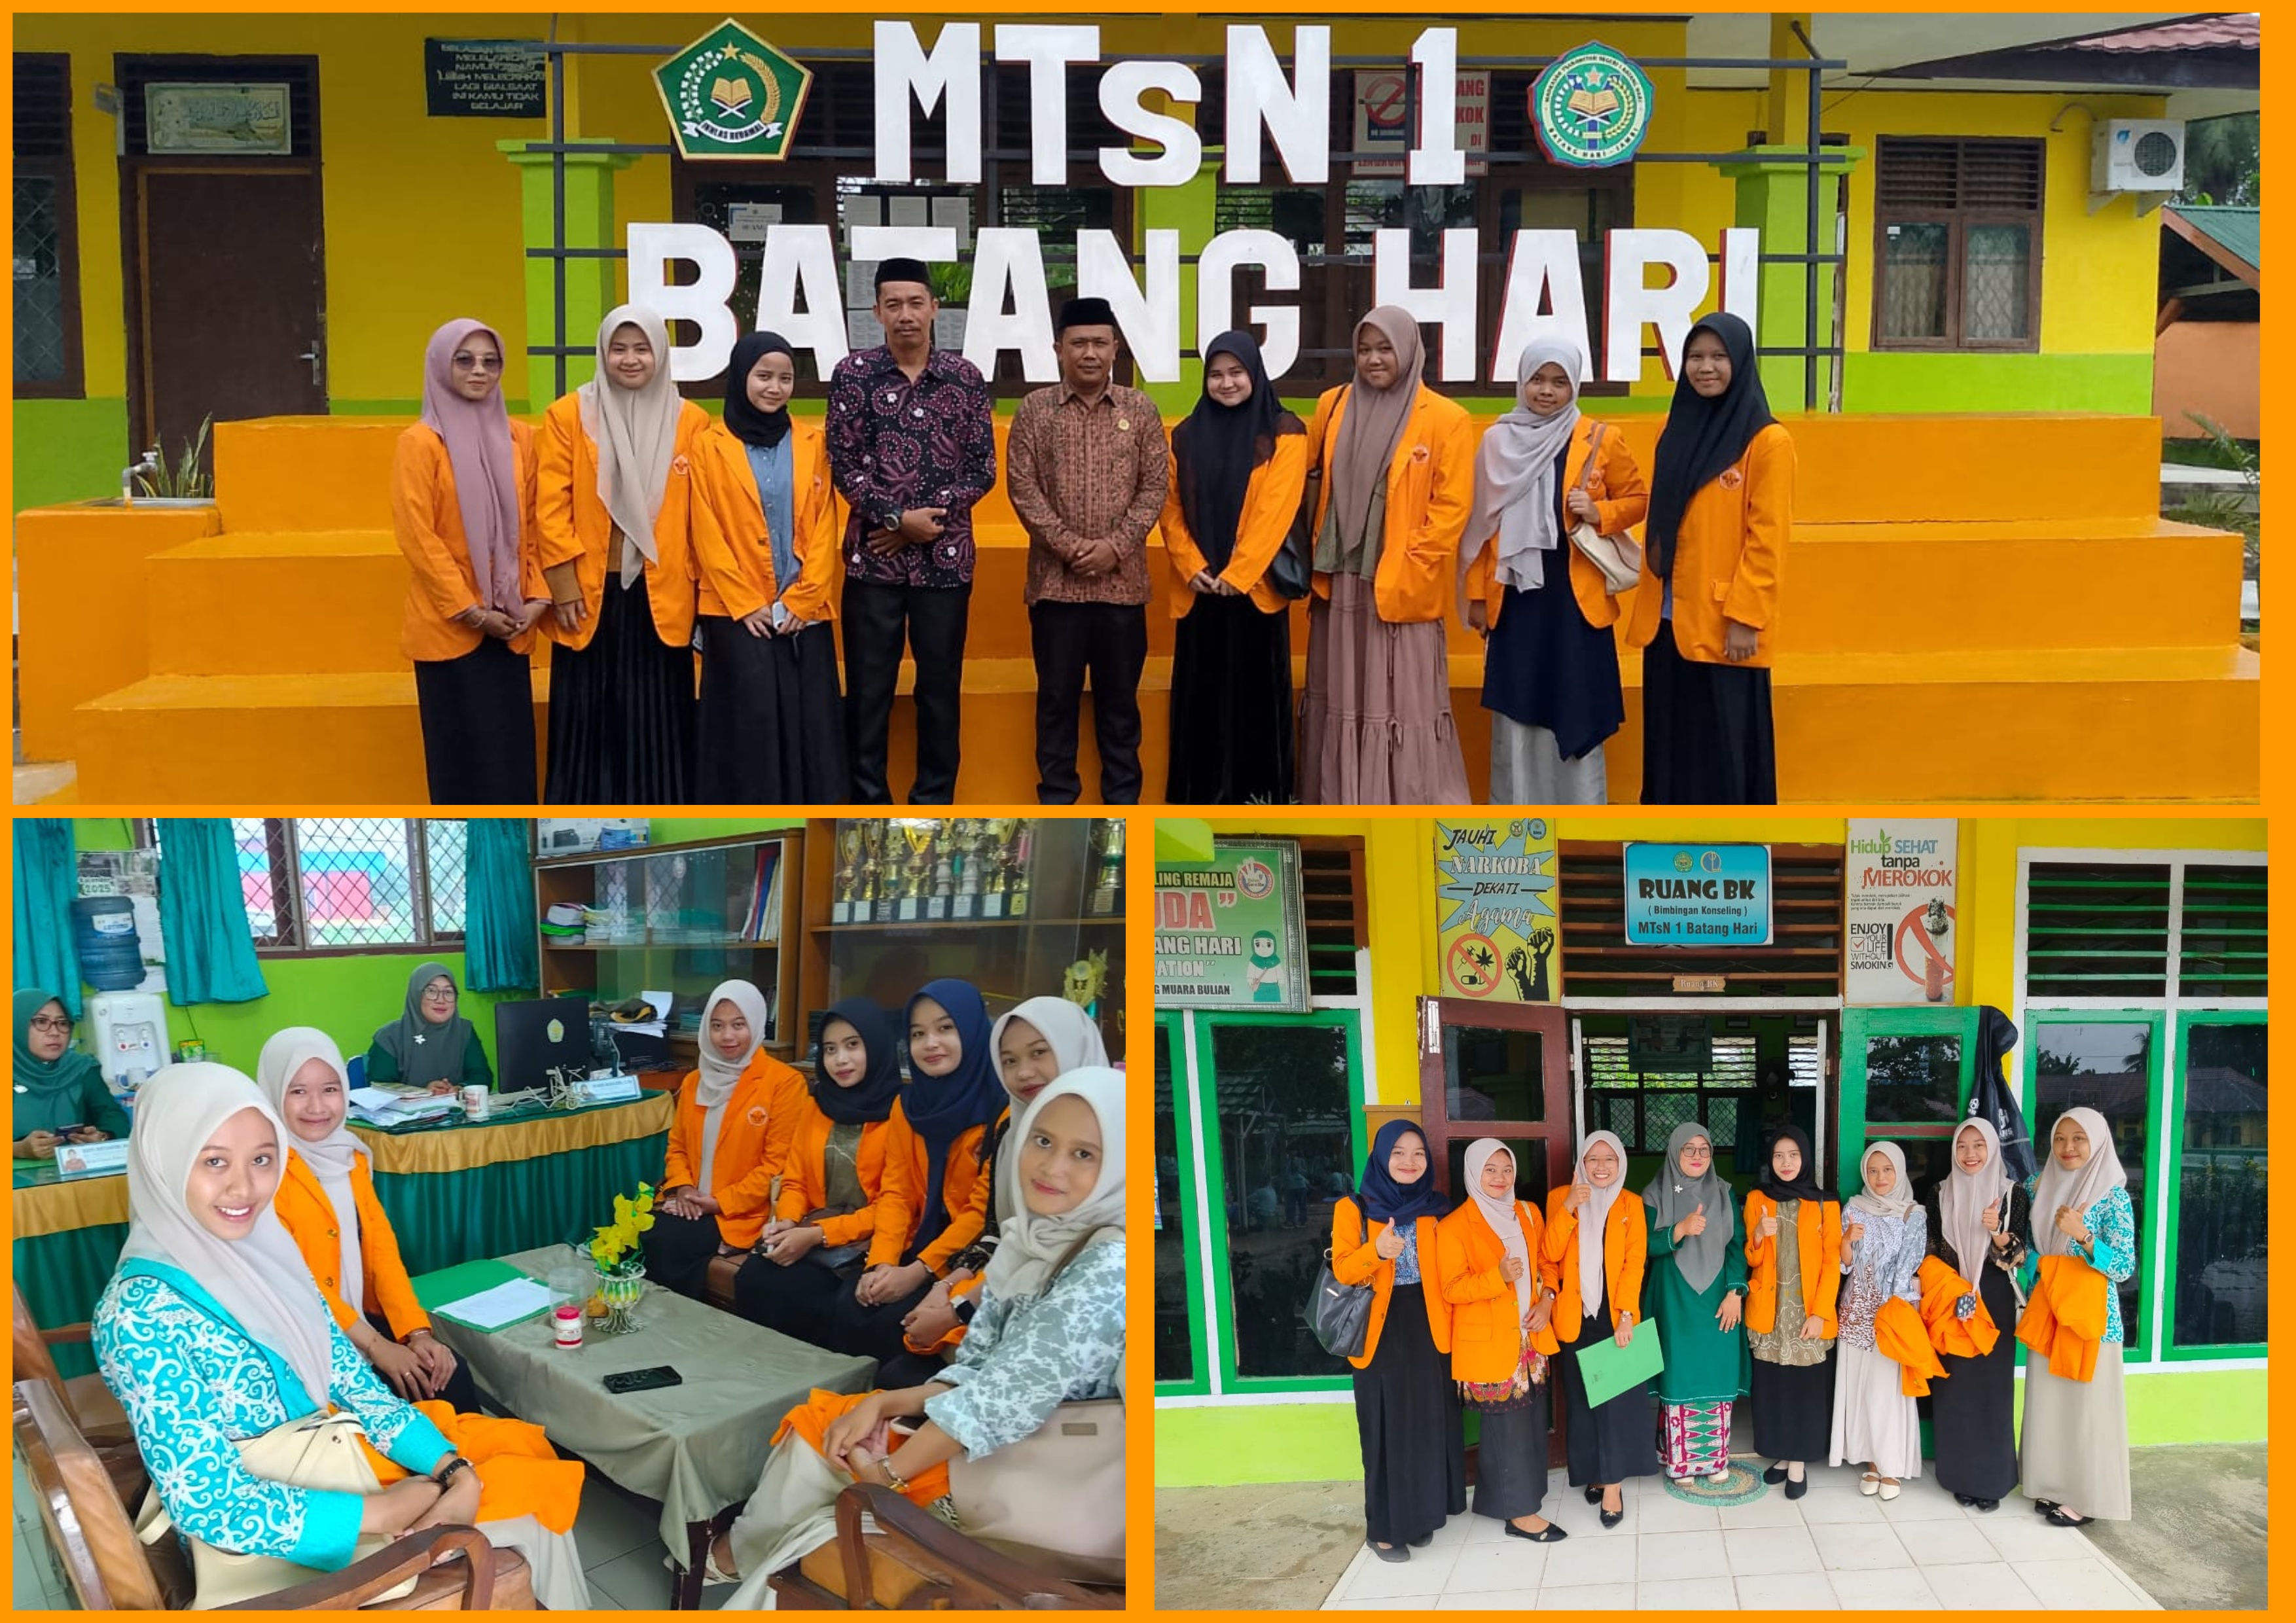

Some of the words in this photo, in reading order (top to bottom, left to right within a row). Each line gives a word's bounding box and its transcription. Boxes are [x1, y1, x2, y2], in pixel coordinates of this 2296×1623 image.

[874, 21, 1330, 187] MTsN
[1408, 27, 1465, 185] 1
[1471, 134, 1481, 146] DI
[1373, 228, 1759, 382] HARI
[1443, 829, 1497, 851] JAUHI
[1850, 838, 1892, 855] Hidup
[1894, 840, 1939, 854] SEHAT
[1450, 855, 1542, 875] NARKOBA
[1880, 855, 1920, 871] tanpa
[1183, 872, 1235, 888] REMAJA
[1861, 868, 1953, 889] MEROKOK
[1473, 882, 1520, 897] DEKATI
[1638, 878, 1719, 900] RUANG
[1723, 879, 1756, 901] BK
[1458, 899, 1535, 934] Agama
[1654, 906, 1698, 917] Bimbingan
[1701, 906, 1742, 917] Konseling
[1638, 921, 1670, 935] MTsN
[1676, 922, 1681, 935] 1
[1687, 921, 1729, 937] Batang
[1733, 921, 1758, 935] Hari
[1850, 923, 1886, 935] ENJOY
[1194, 936, 1242, 956] HARI
[1867, 942, 1886, 952] LIFE
[1850, 961, 1893, 970] SMOKING
[1162, 984, 1195, 995] MUARA
[1198, 984, 1230, 995] BULIAN
[1680, 979, 1705, 991] Ruang
[1707, 979, 1719, 989] BK
